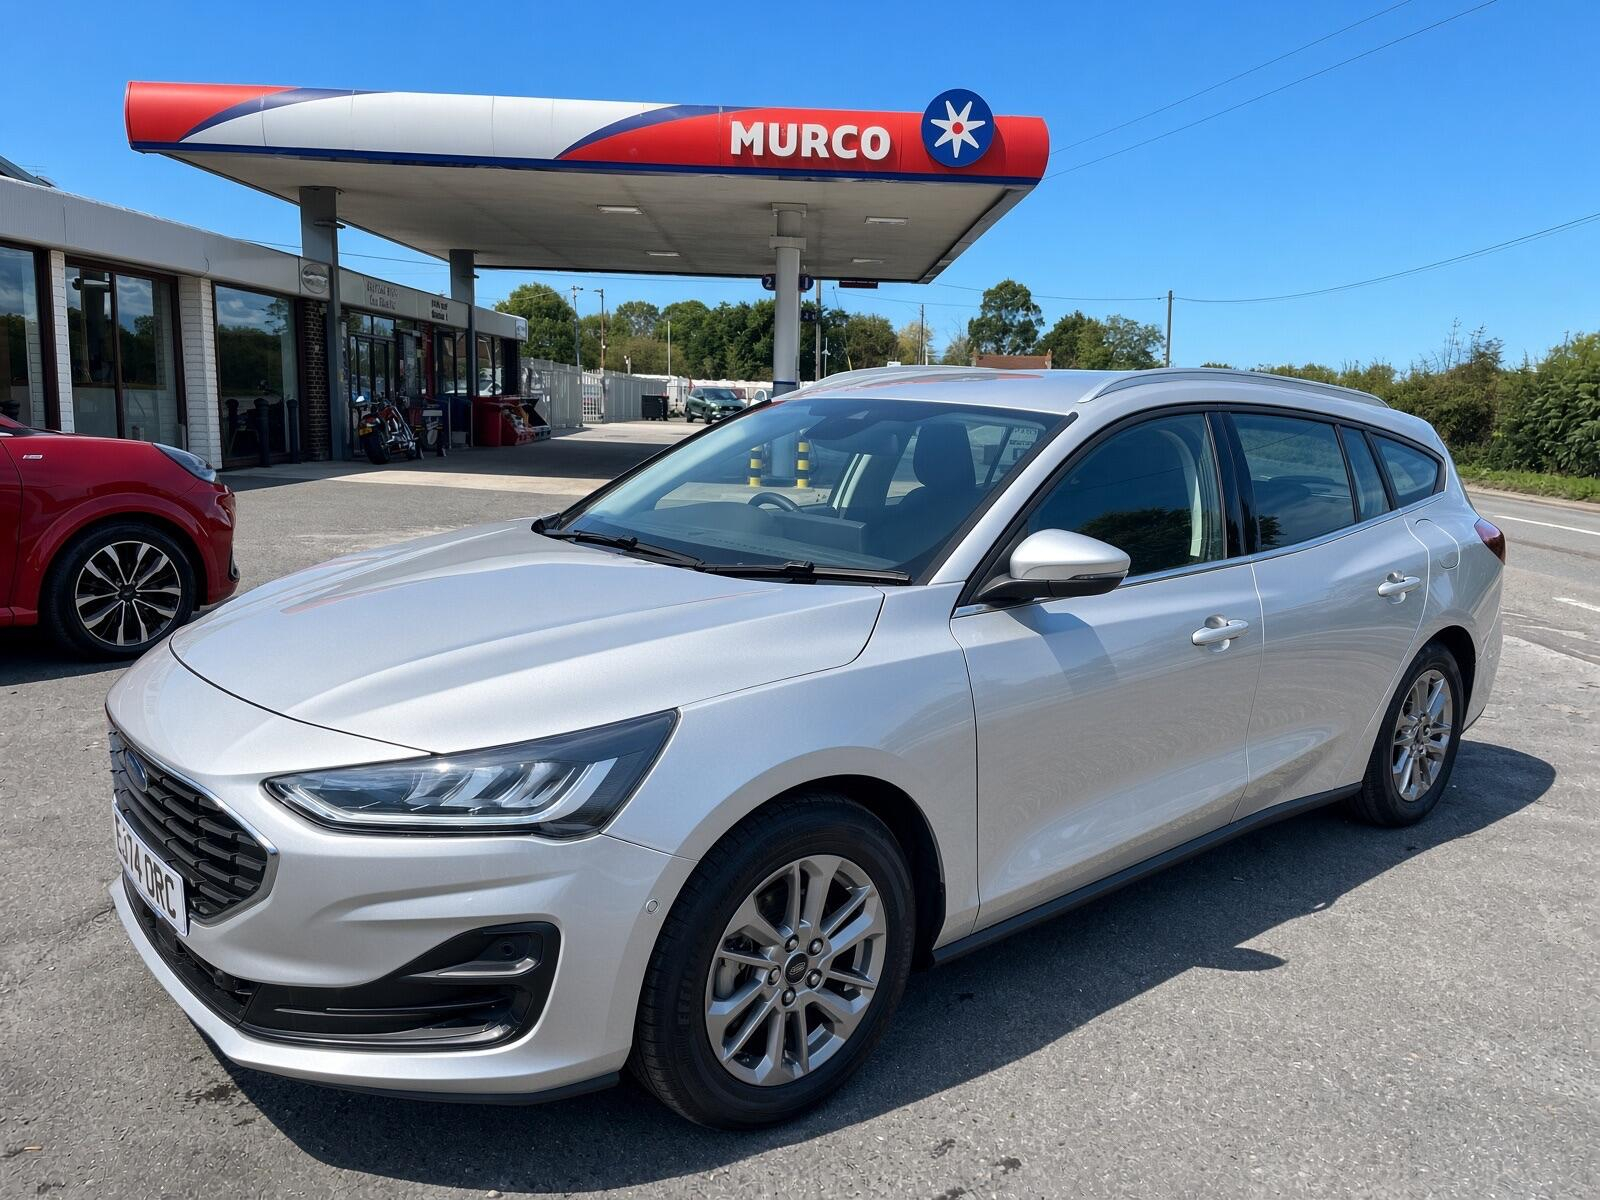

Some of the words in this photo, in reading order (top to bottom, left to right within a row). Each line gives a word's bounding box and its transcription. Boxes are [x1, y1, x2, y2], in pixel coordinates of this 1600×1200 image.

[730, 120, 891, 160] MURCO
[765, 276, 772, 288] 2
[804, 277, 809, 289] 1
[144, 853, 177, 919] ORC
